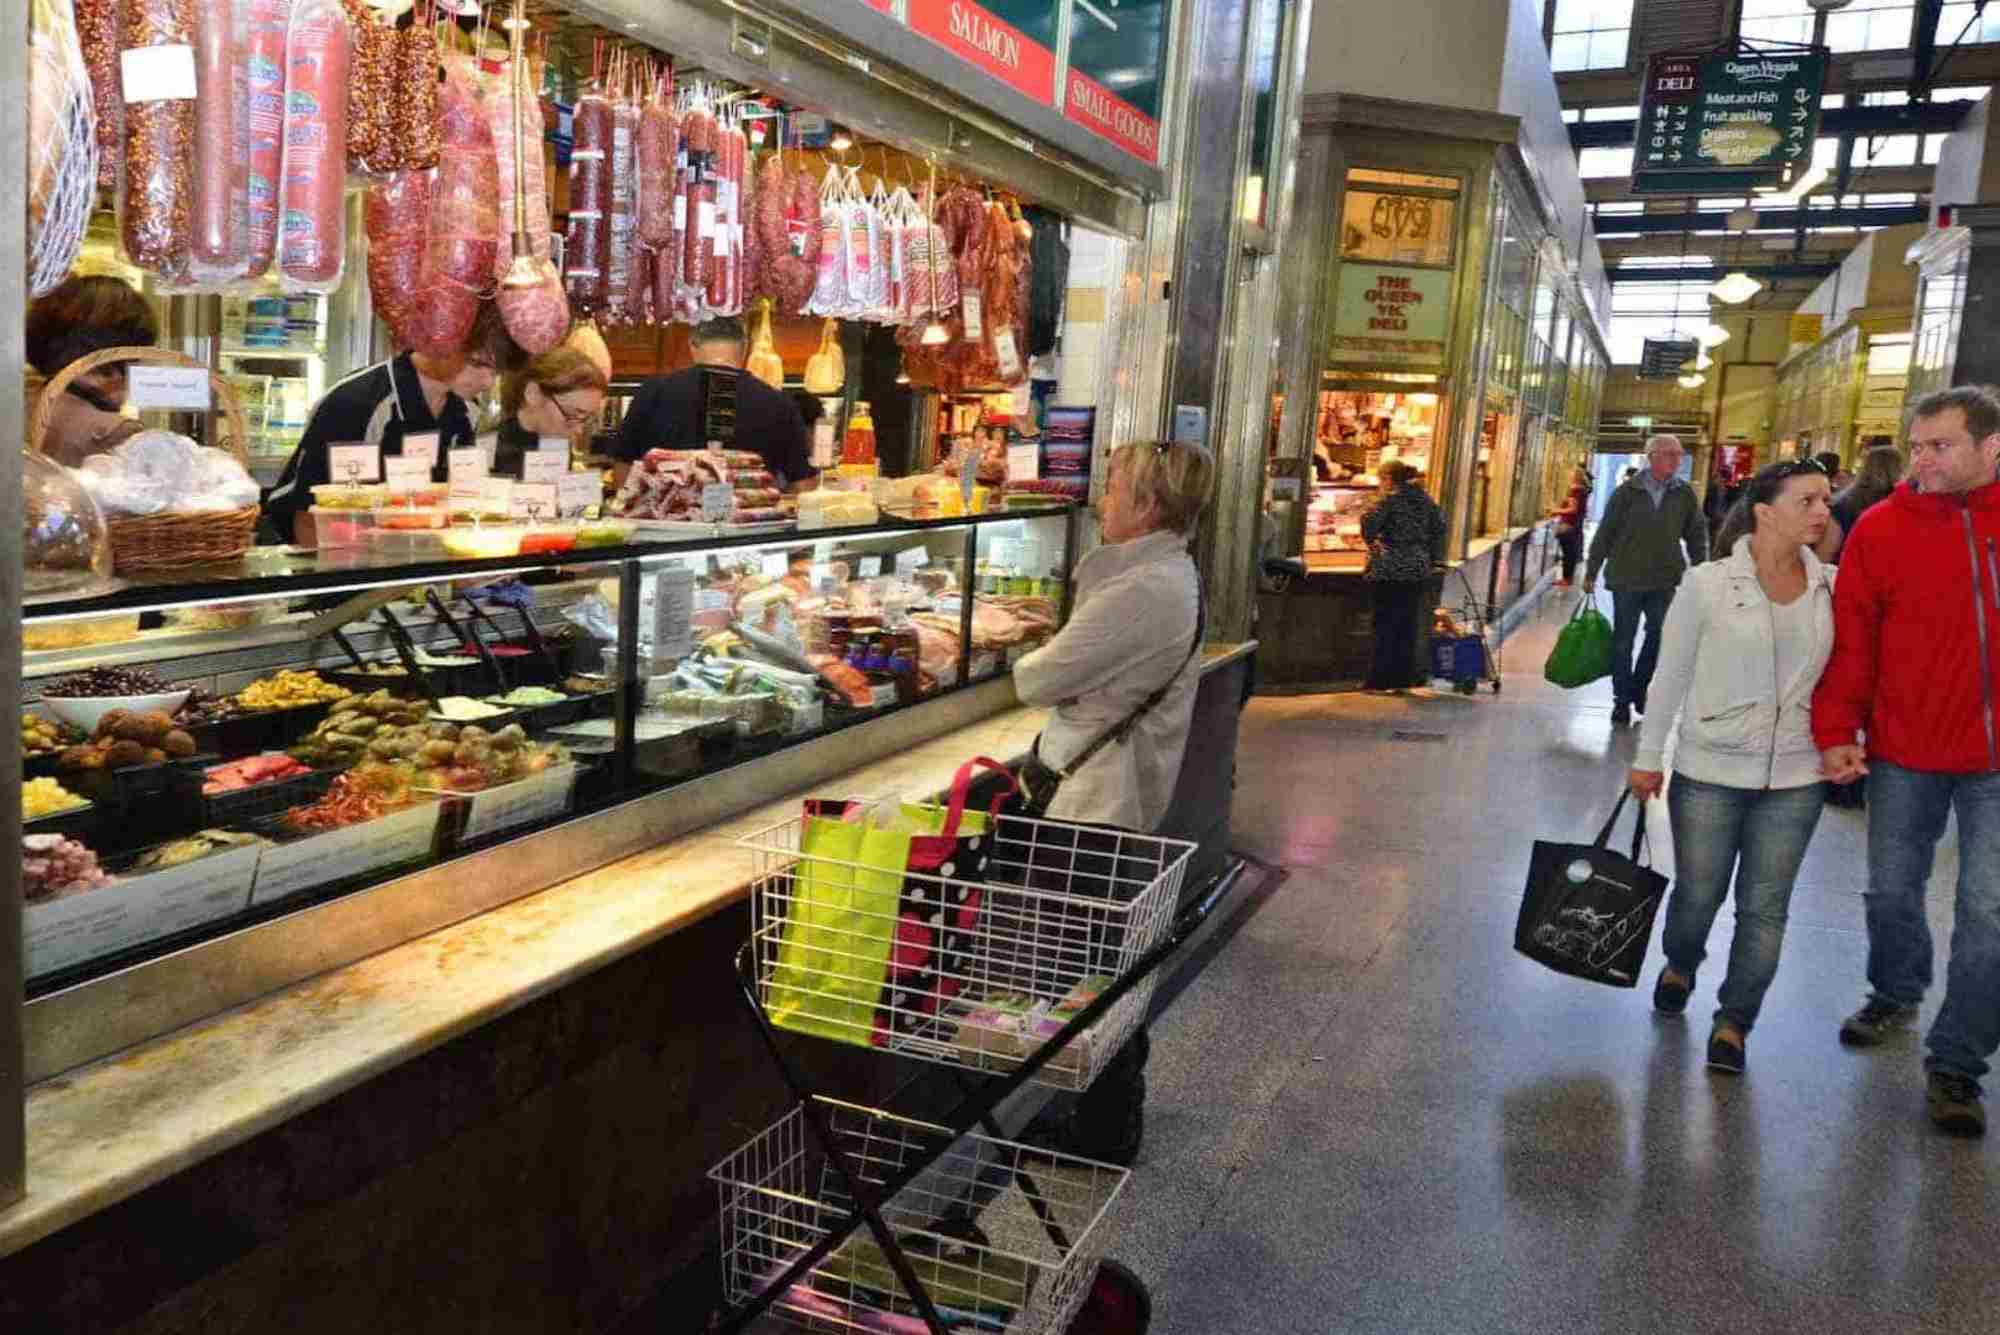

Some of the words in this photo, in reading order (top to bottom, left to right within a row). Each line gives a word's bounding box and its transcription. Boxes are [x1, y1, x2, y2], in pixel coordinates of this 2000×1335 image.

[951, 2, 1020, 70] SALMON
[1657, 77, 1695, 91] DELI
[1705, 92, 1732, 105] Meat
[1733, 92, 1758, 104] and
[1759, 91, 1779, 104] Fish
[1072, 79, 1112, 128] SMALL
[1114, 104, 1154, 149] GOODS
[1703, 110, 1728, 123] Fruit
[1729, 109, 1751, 122] and
[1752, 109, 1773, 124] Veg
[1376, 275, 1411, 289] THE
[1364, 289, 1424, 304] QUEEN
[1368, 317, 1408, 331] DELI
